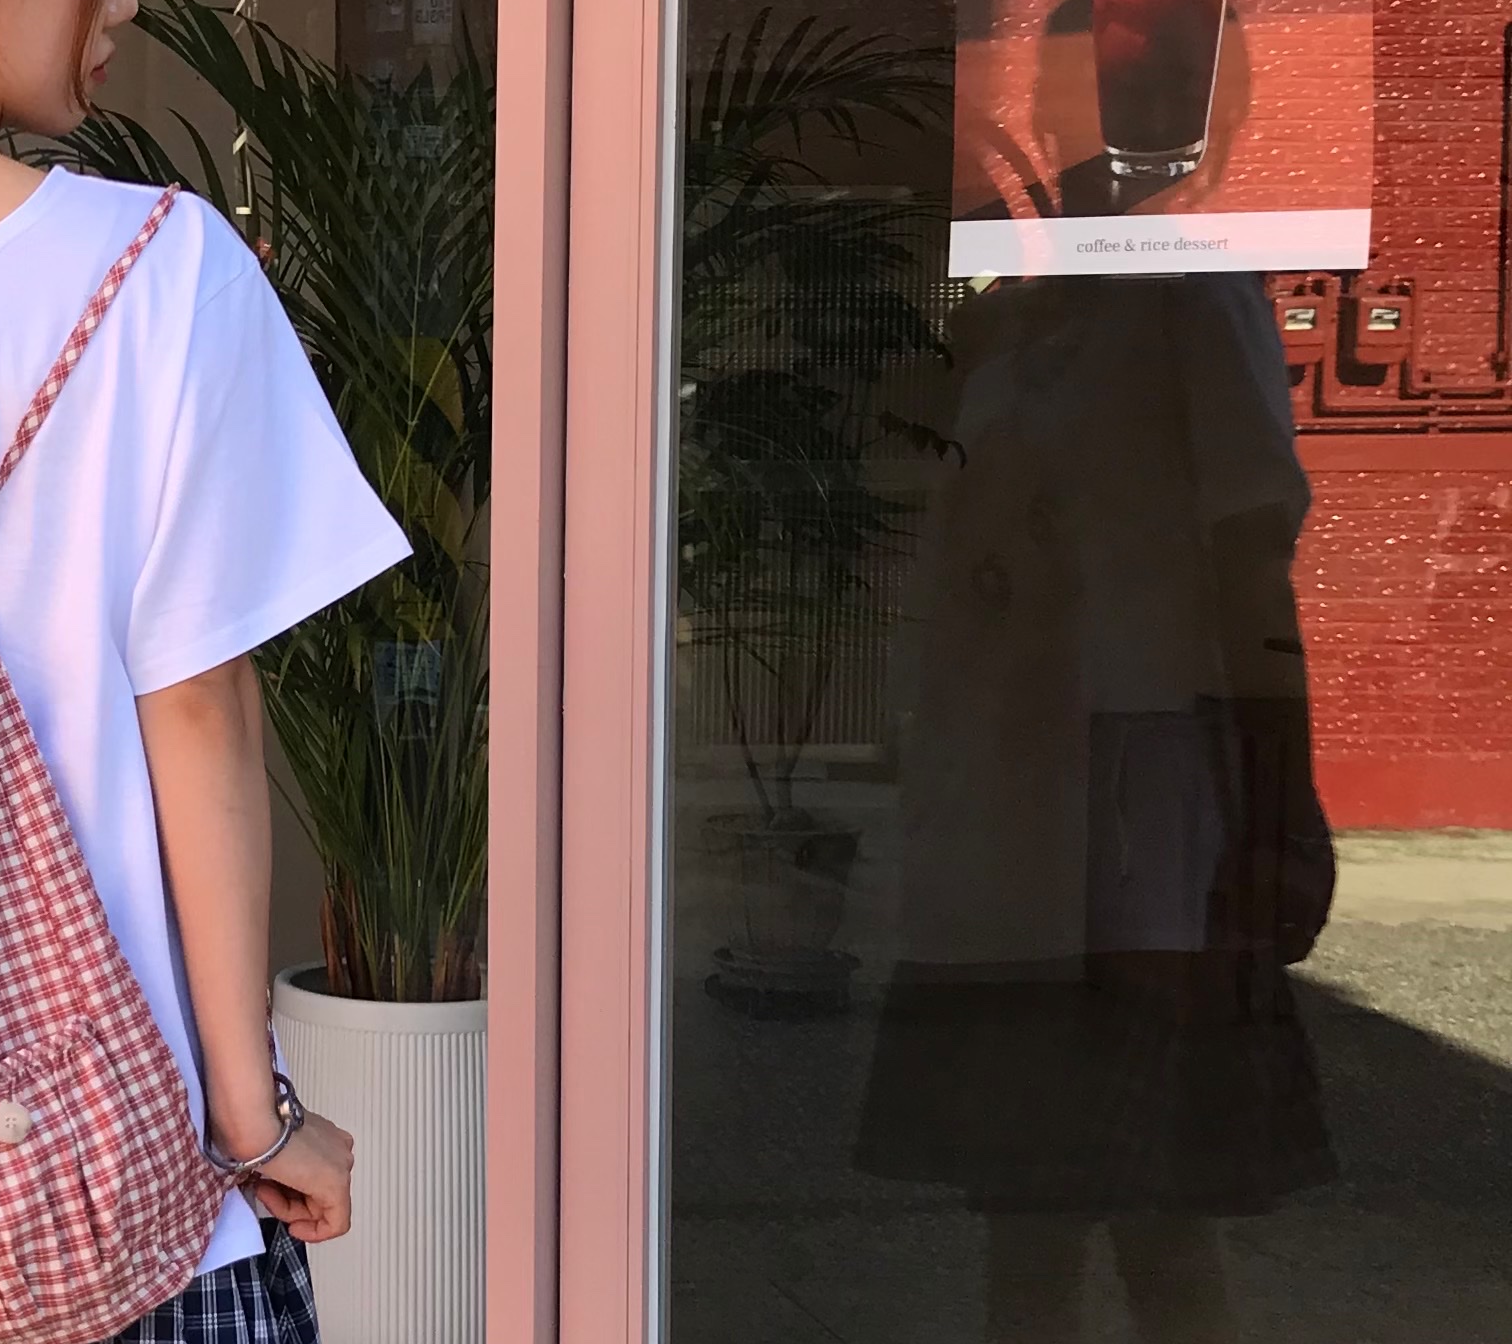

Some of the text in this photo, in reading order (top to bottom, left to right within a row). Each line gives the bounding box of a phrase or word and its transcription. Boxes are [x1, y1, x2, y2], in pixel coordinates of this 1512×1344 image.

[1076, 237, 1229, 253] coffee & rice dessert
